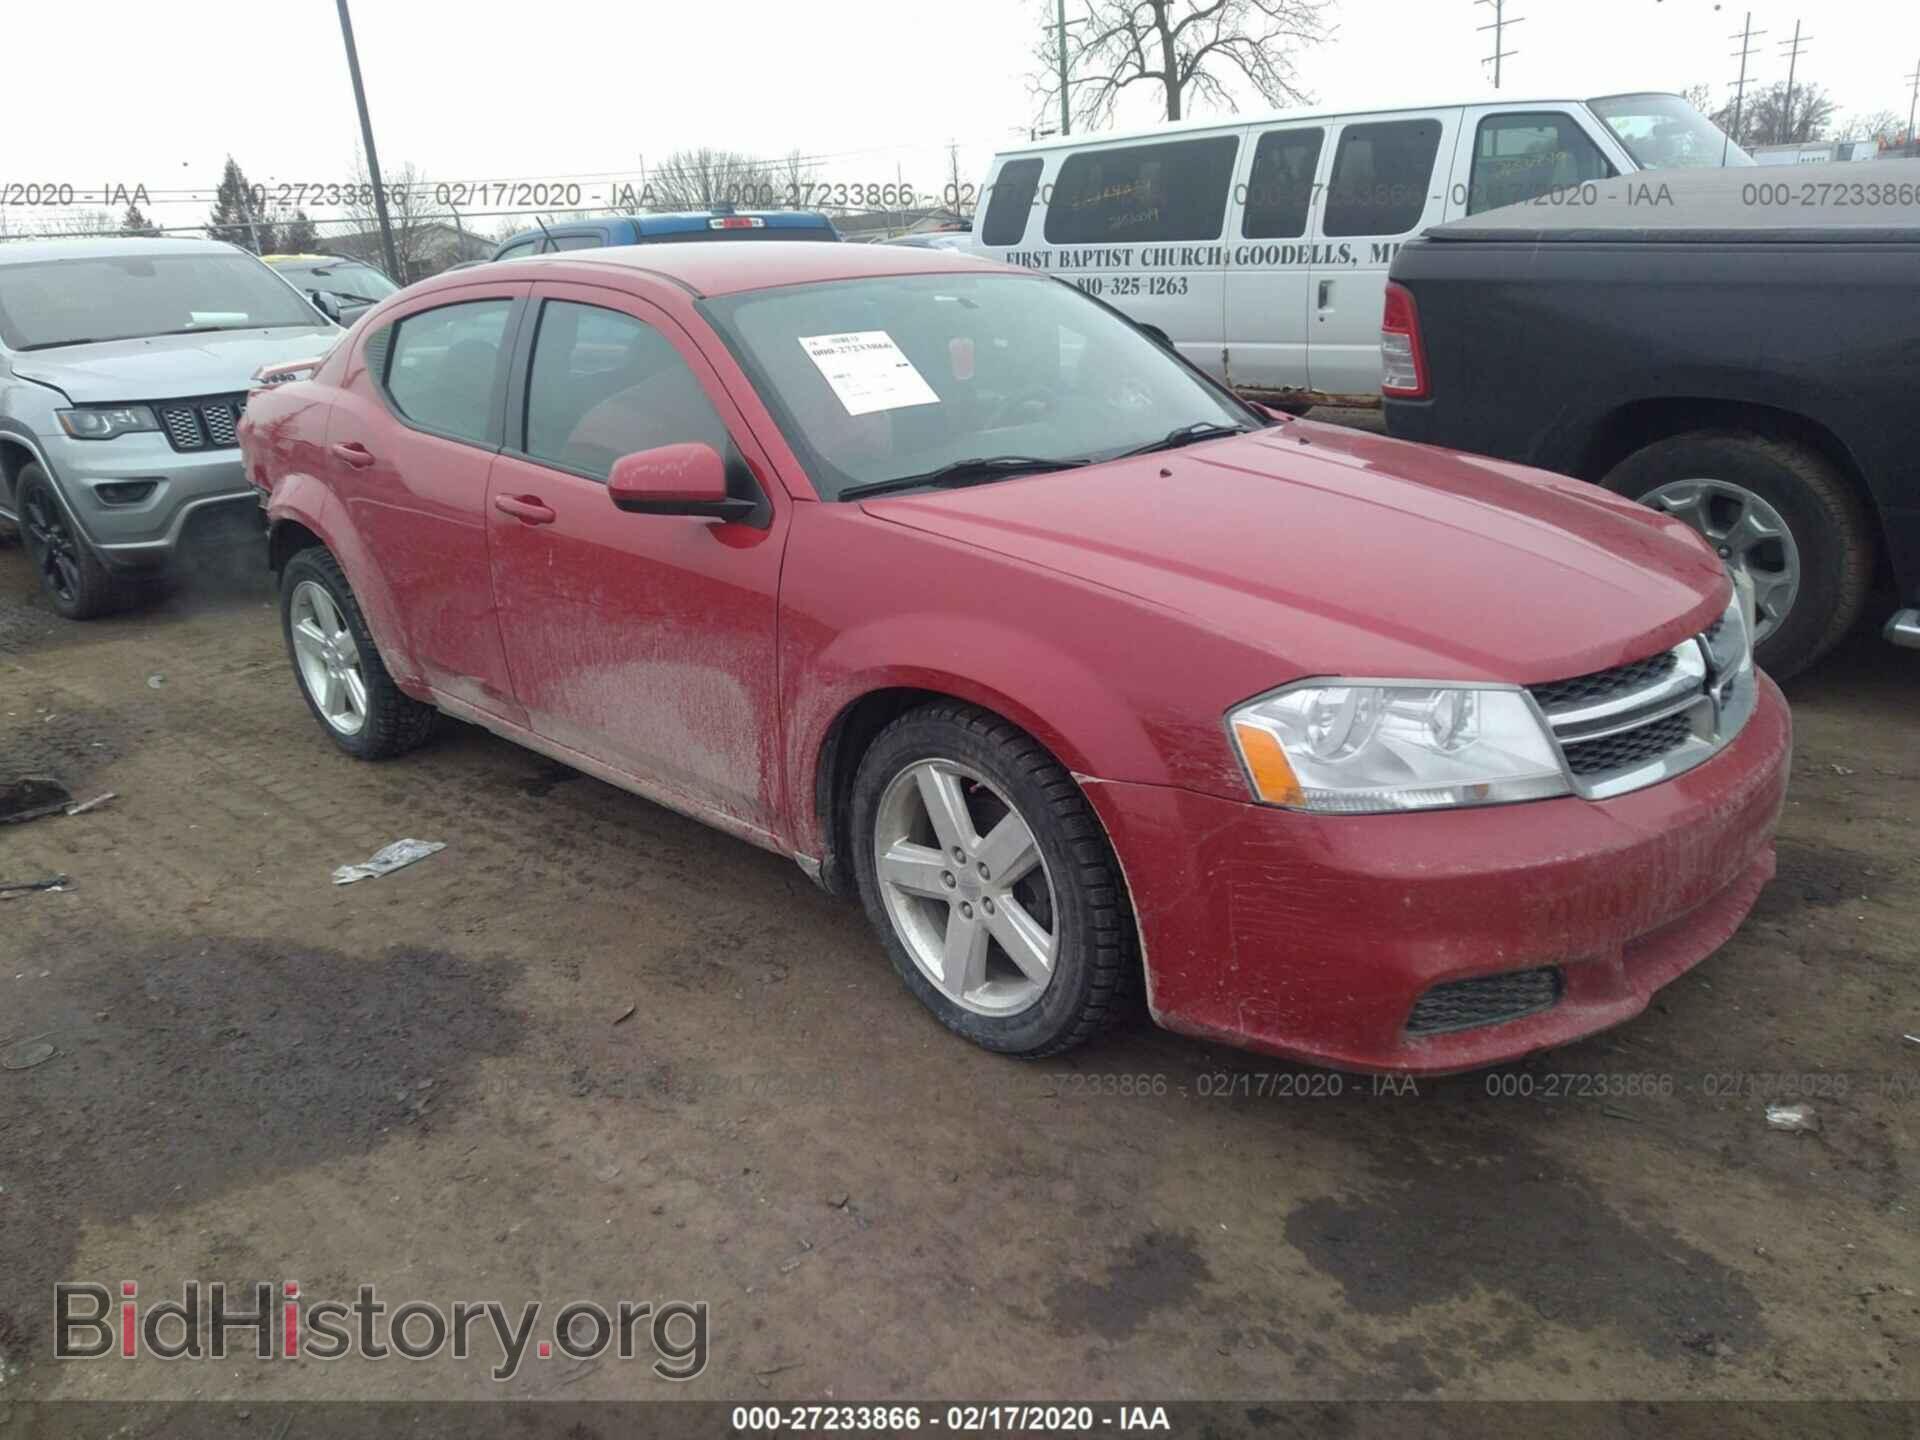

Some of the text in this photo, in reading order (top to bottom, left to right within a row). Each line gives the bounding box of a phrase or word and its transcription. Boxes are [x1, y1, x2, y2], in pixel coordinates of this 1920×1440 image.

[1006, 250, 1052, 268] FIRST
[1060, 247, 1134, 268] BAPTIST
[1235, 243, 1358, 267] GOODELLS,
[1077, 276, 1188, 296] 810-325-1263
